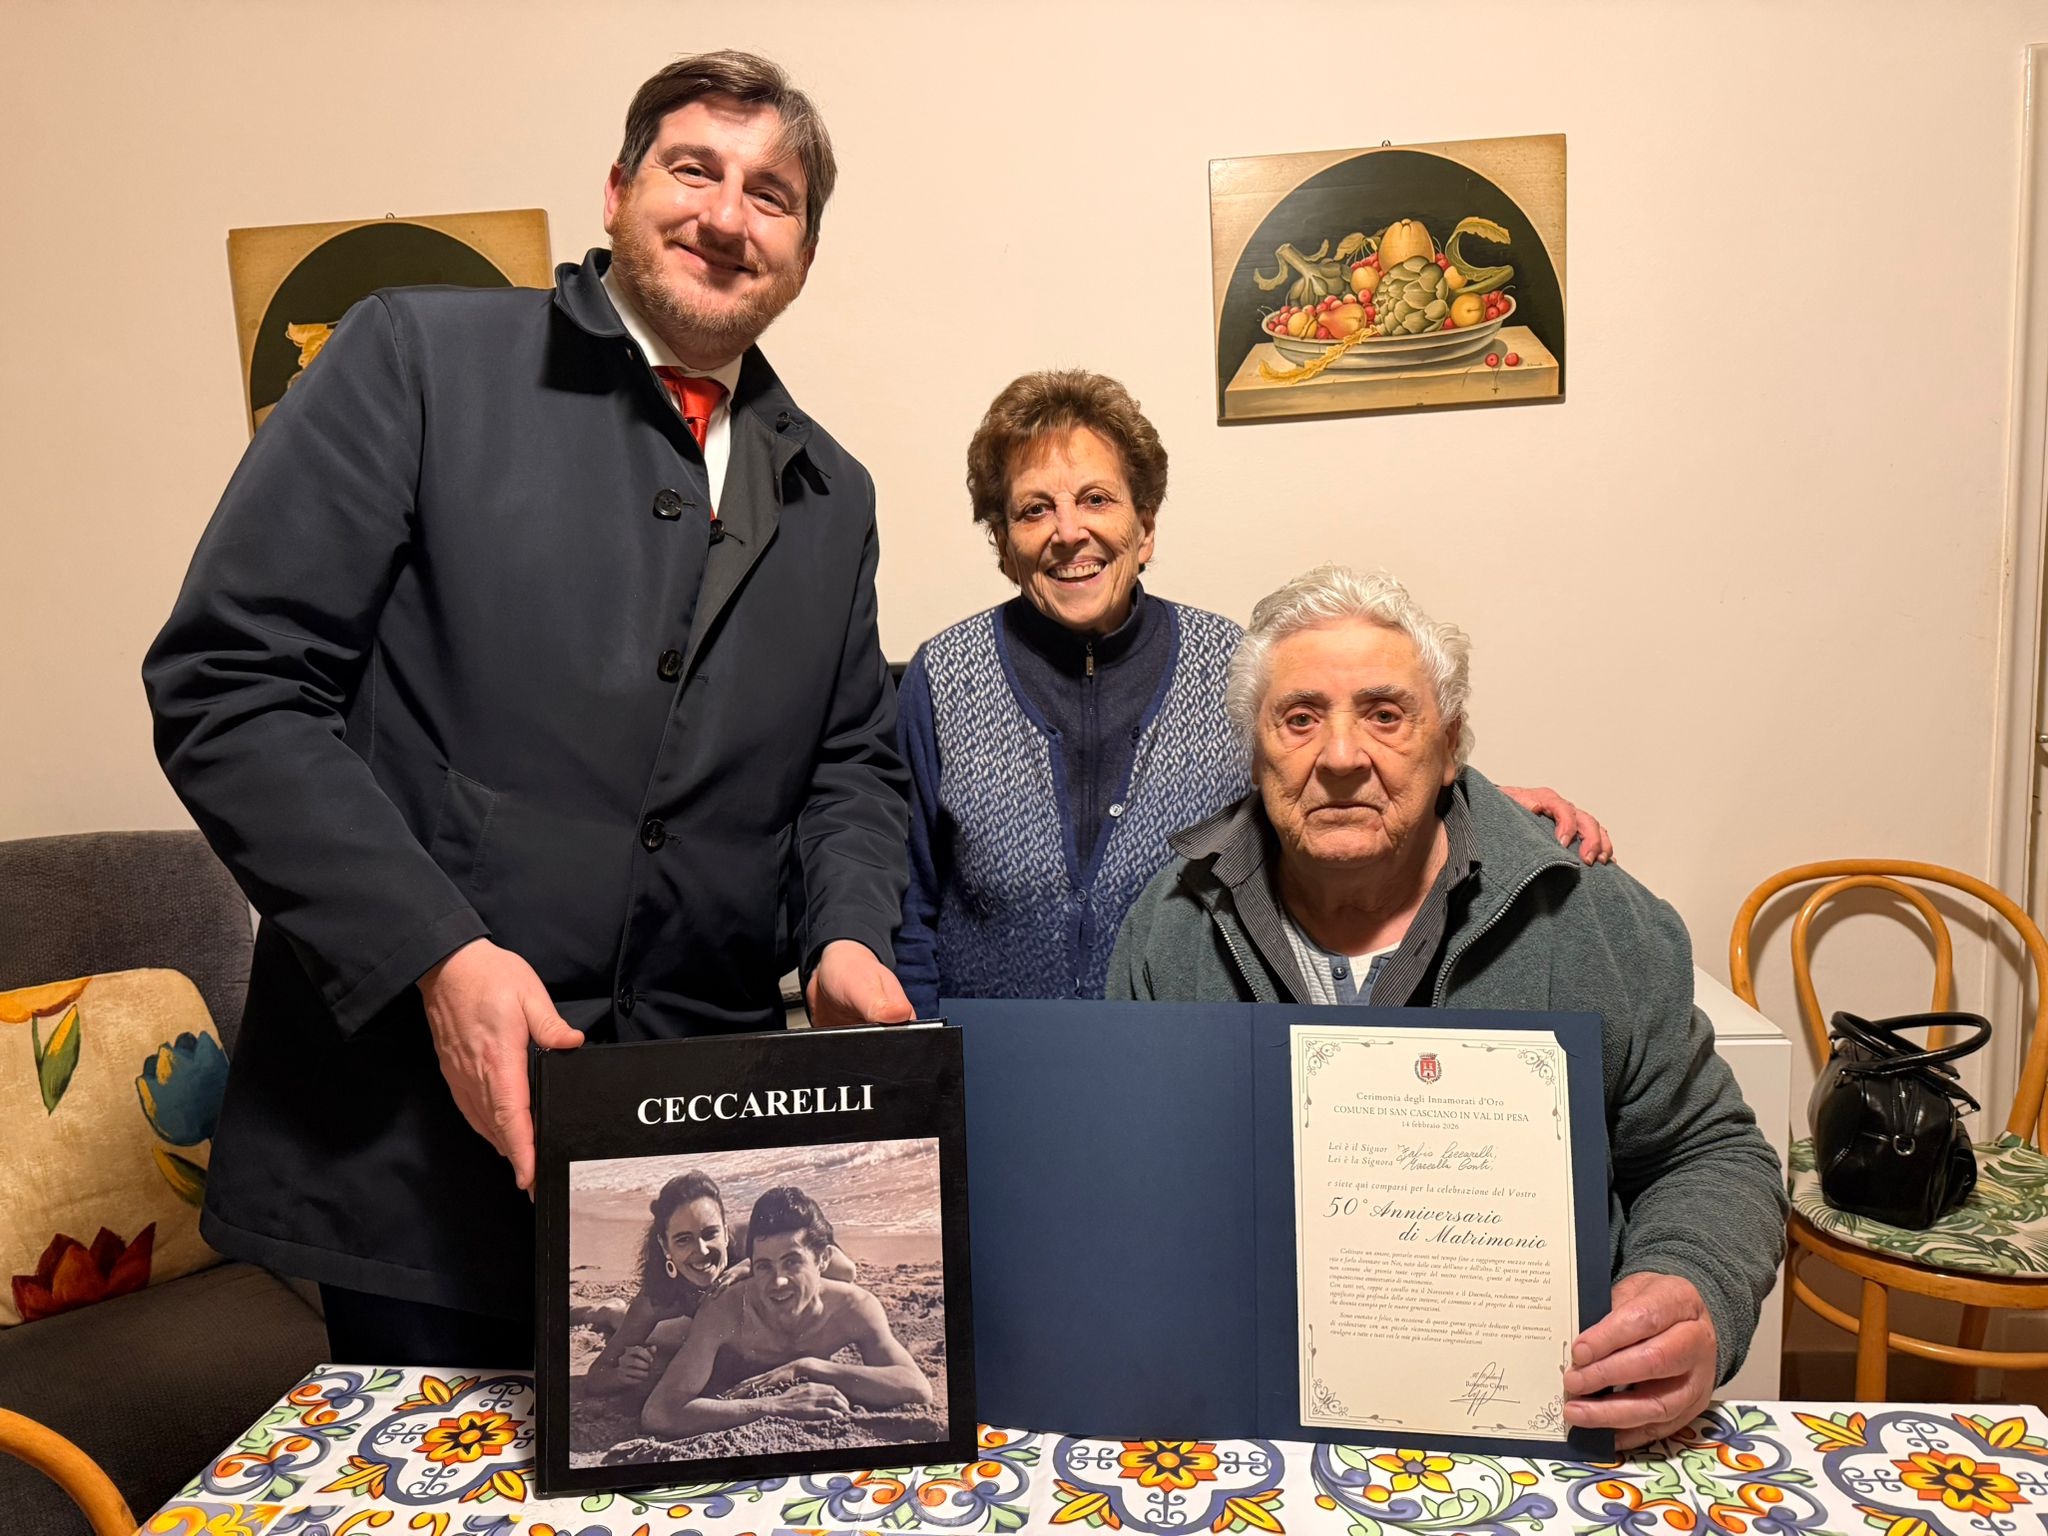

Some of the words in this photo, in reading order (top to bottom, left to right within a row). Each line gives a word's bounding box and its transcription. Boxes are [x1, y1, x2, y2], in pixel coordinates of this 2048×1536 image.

[637, 1084, 874, 1125] CECCARELLI
[1356, 1092, 1401, 1103] Cerimonia
[1404, 1093, 1425, 1104] degli
[1427, 1095, 1476, 1106] Innamorati
[1478, 1097, 1504, 1107] d'Oro
[1333, 1105, 1375, 1115] COMUNE
[1377, 1107, 1388, 1116] DI
[1389, 1107, 1407, 1117] SAN
[1410, 1108, 1458, 1119] CASCIANO
[1459, 1110, 1471, 1119] IN
[1473, 1111, 1492, 1121] VAL
[1494, 1112, 1504, 1121] DI
[1506, 1113, 1529, 1122] PESA
[1411, 1120, 1441, 1130] febbraio
[1442, 1122, 1459, 1130] 2026
[1328, 1141, 1341, 1151] Lei
[1343, 1142, 1349, 1151] è
[1351, 1142, 1359, 1152] il
[1360, 1143, 1388, 1154] Signor
[1327, 1154, 1340, 1164] Lei
[1342, 1155, 1349, 1165] è
[1350, 1156, 1358, 1165] la
[1360, 1156, 1393, 1168] Signora
[1334, 1179, 1353, 1188] siete
[1355, 1181, 1369, 1190] qui
[1371, 1182, 1407, 1192] comparsi
[1410, 1185, 1424, 1194] per
[1426, 1184, 1434, 1193] la
[1437, 1185, 1489, 1196] celebrazione
[1492, 1188, 1505, 1197] del
[1508, 1188, 1536, 1199] Vostro
[1370, 1200, 1503, 1225] Anniversario
[1398, 1222, 1419, 1242] di
[1425, 1225, 1548, 1250] Matrimonio
